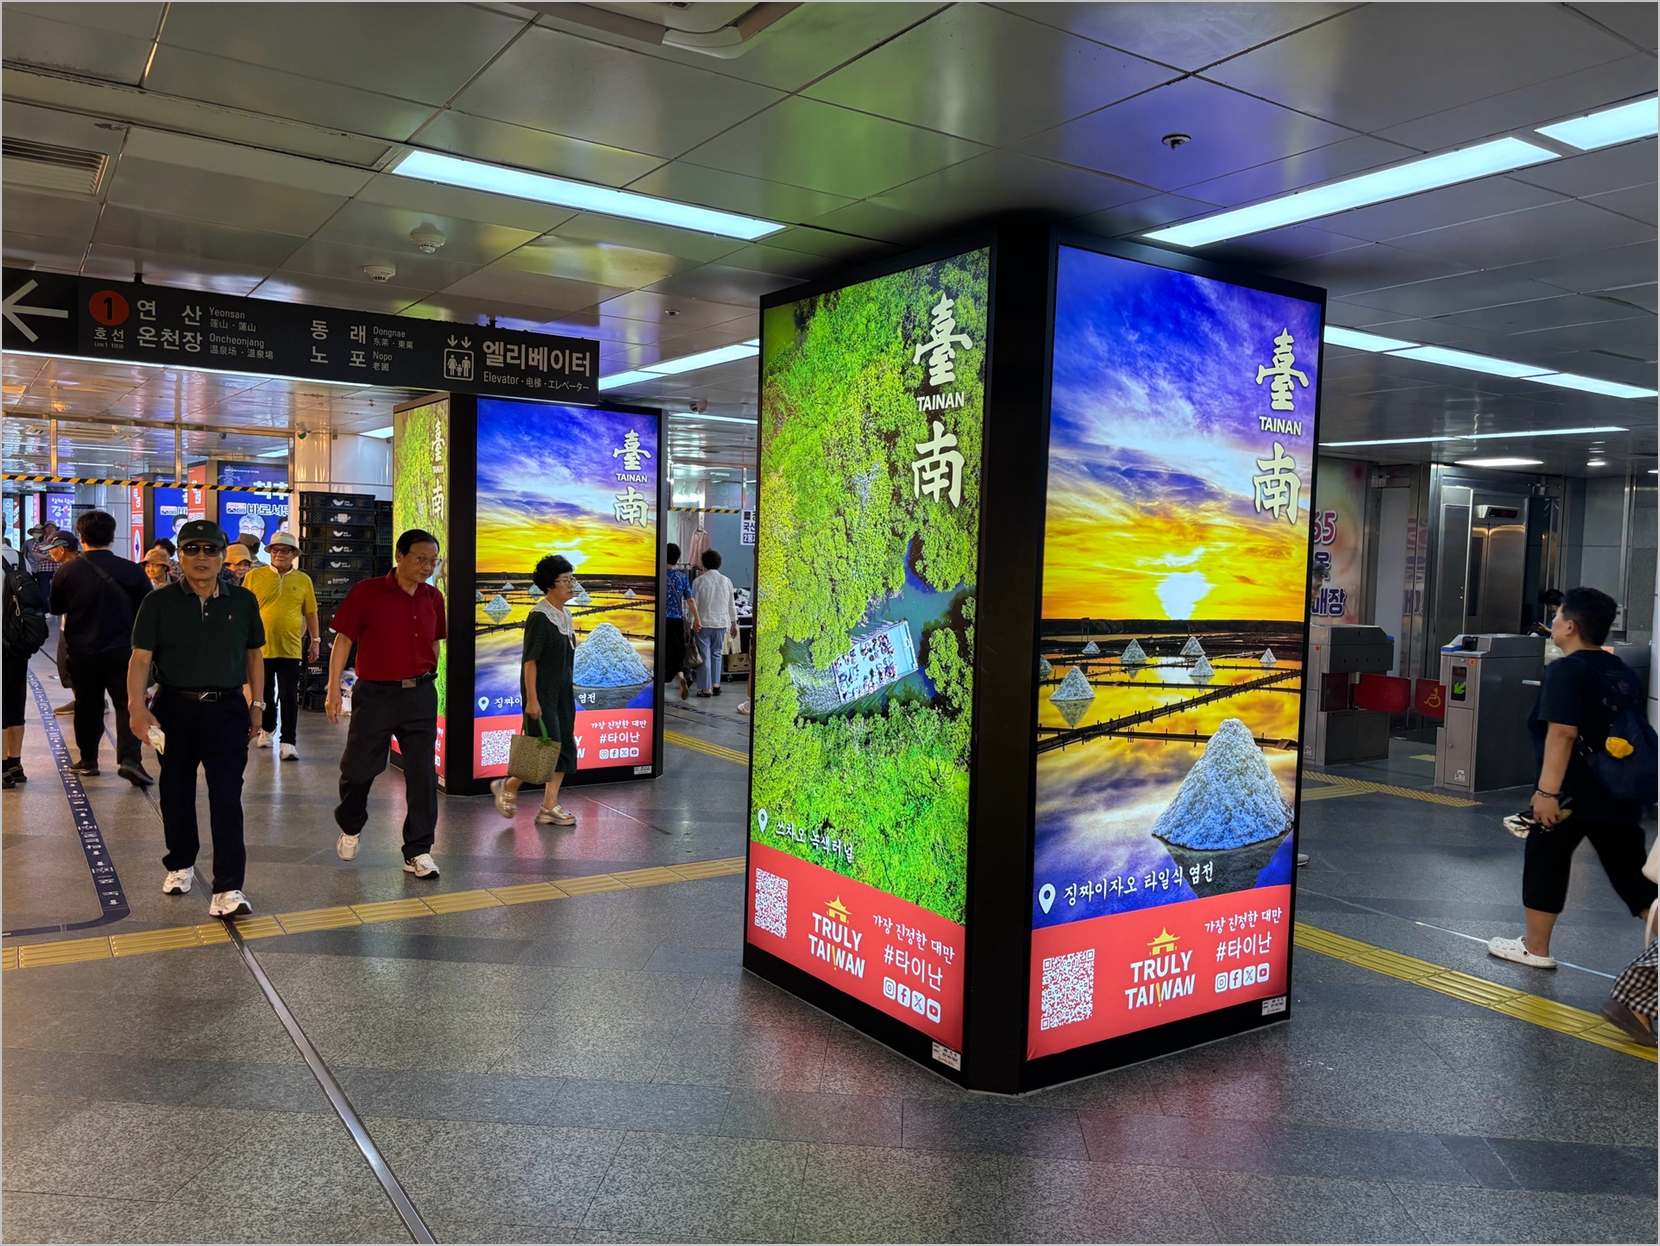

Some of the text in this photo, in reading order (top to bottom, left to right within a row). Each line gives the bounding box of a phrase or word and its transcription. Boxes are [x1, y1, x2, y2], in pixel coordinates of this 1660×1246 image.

[103, 297, 113, 321] 1
[209, 307, 246, 320] Yeonsan
[136, 325, 204, 353] 온천장
[209, 333, 265, 350] Oncheonjang
[373, 326, 406, 339] Dongnae
[373, 351, 393, 362] Nopo
[482, 340, 591, 378] 엘리베이터
[483, 371, 519, 386] Elevator
[548, 379, 590, 392] エレベーター
[916, 391, 965, 413] TAINAN
[1258, 415, 1302, 436] TAINAN
[615, 473, 648, 484] TAINAN
[911, 420, 966, 509] 南
[1252, 441, 1301, 525] 南
[493, 692, 596, 708] 징짜이 염전
[599, 731, 641, 744] #타이난
[775, 820, 807, 844] 쓰차오
[1063, 860, 1215, 907] 징짜이자오 타일식 염전
[811, 910, 864, 953] TRULY
[1204, 906, 1283, 934] 가장 진정한 대만
[872, 914, 956, 966] 가장 진정한 대만
[1216, 931, 1273, 962] #타이난
[807, 933, 867, 979] TAIWAN
[883, 944, 944, 993] #타이난
[1130, 949, 1194, 984] TRULY
[1124, 973, 1197, 1010] TAIWAN
